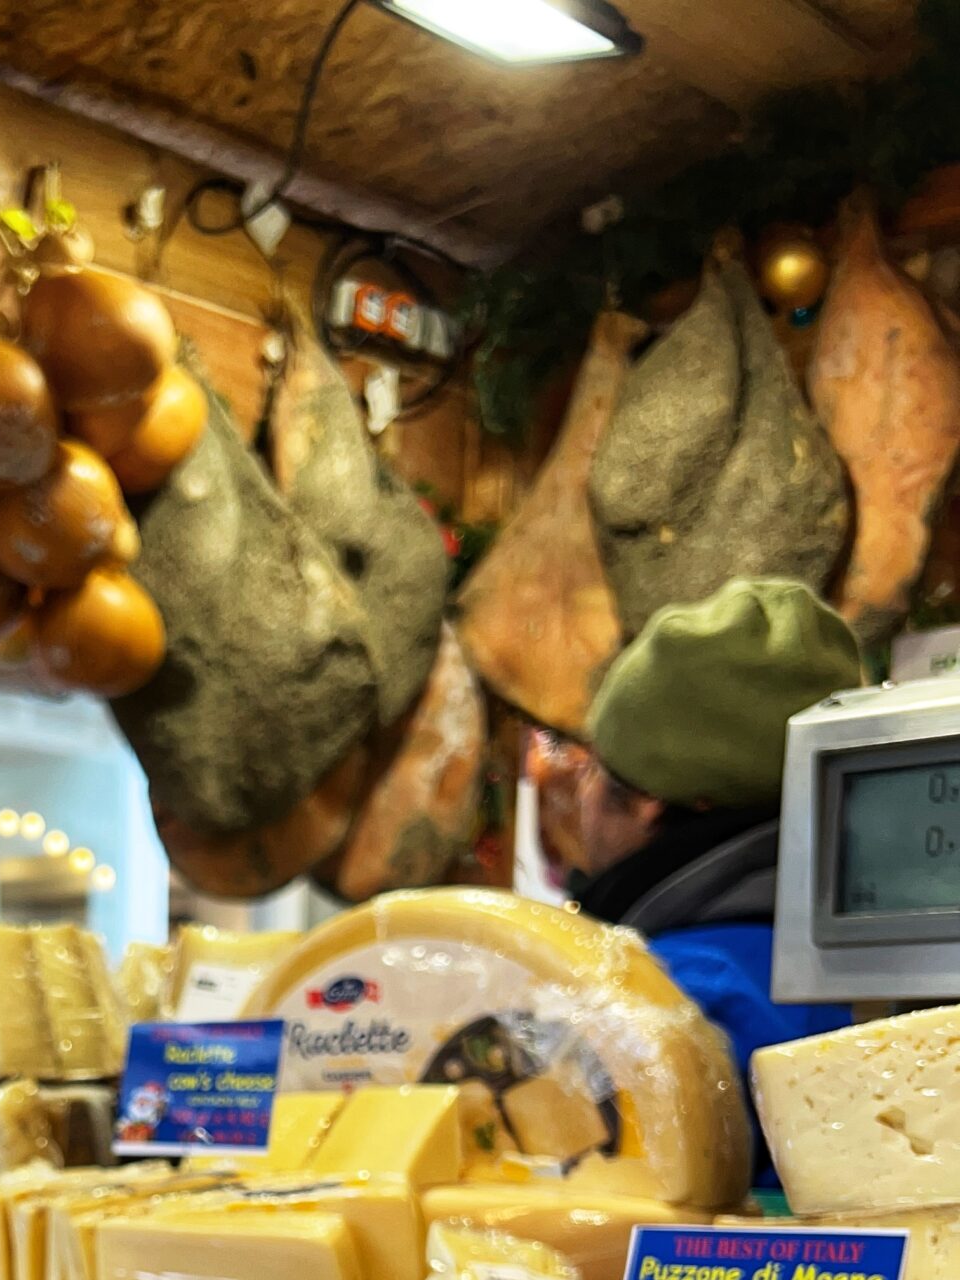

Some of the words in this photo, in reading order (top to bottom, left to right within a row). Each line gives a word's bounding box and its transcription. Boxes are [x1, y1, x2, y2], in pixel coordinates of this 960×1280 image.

[674, 1236, 712, 1259] THE
[717, 1237, 768, 1260] BEST
[770, 1240, 802, 1260] OF
[803, 1240, 865, 1264] ITALY
